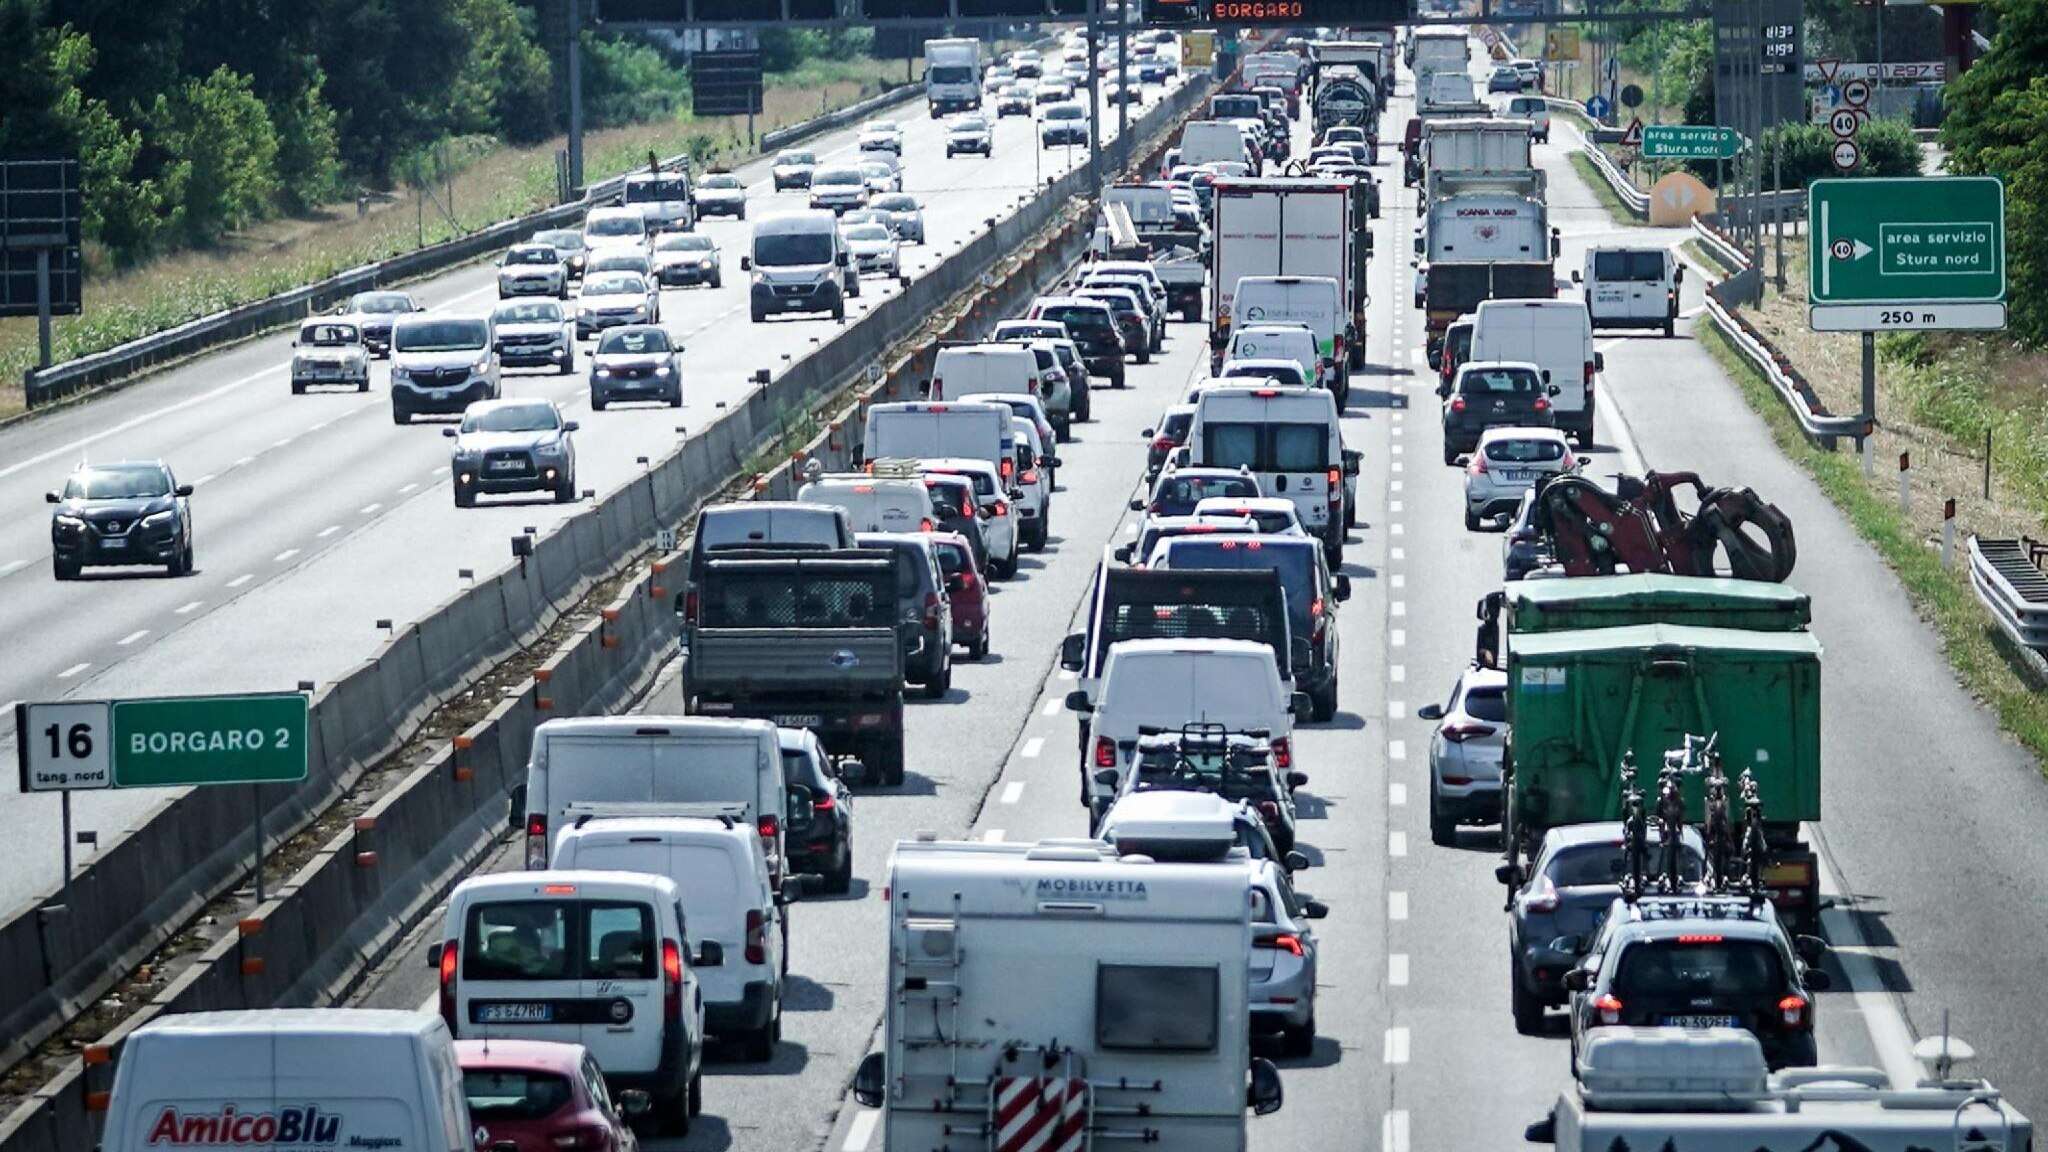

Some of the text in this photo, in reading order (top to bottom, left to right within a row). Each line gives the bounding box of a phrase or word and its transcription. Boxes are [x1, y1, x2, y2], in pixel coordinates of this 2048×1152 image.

[1214, 3, 1302, 17] BORGARO
[1836, 117, 1853, 130] 40
[1648, 130, 1729, 141] area servizo
[1655, 143, 1688, 154] Stura
[1887, 230, 1986, 244] area servizio
[1836, 244, 1849, 255] 40
[1896, 252, 1980, 265] Stura nord
[1880, 311, 1936, 324] 250 m
[45, 722, 93, 759] 16
[130, 727, 290, 754] BORGARO 2
[36, 769, 105, 784] tang. nord
[1037, 879, 1147, 893] MOBILVETTA
[149, 1106, 341, 1143] AmicoBlu
